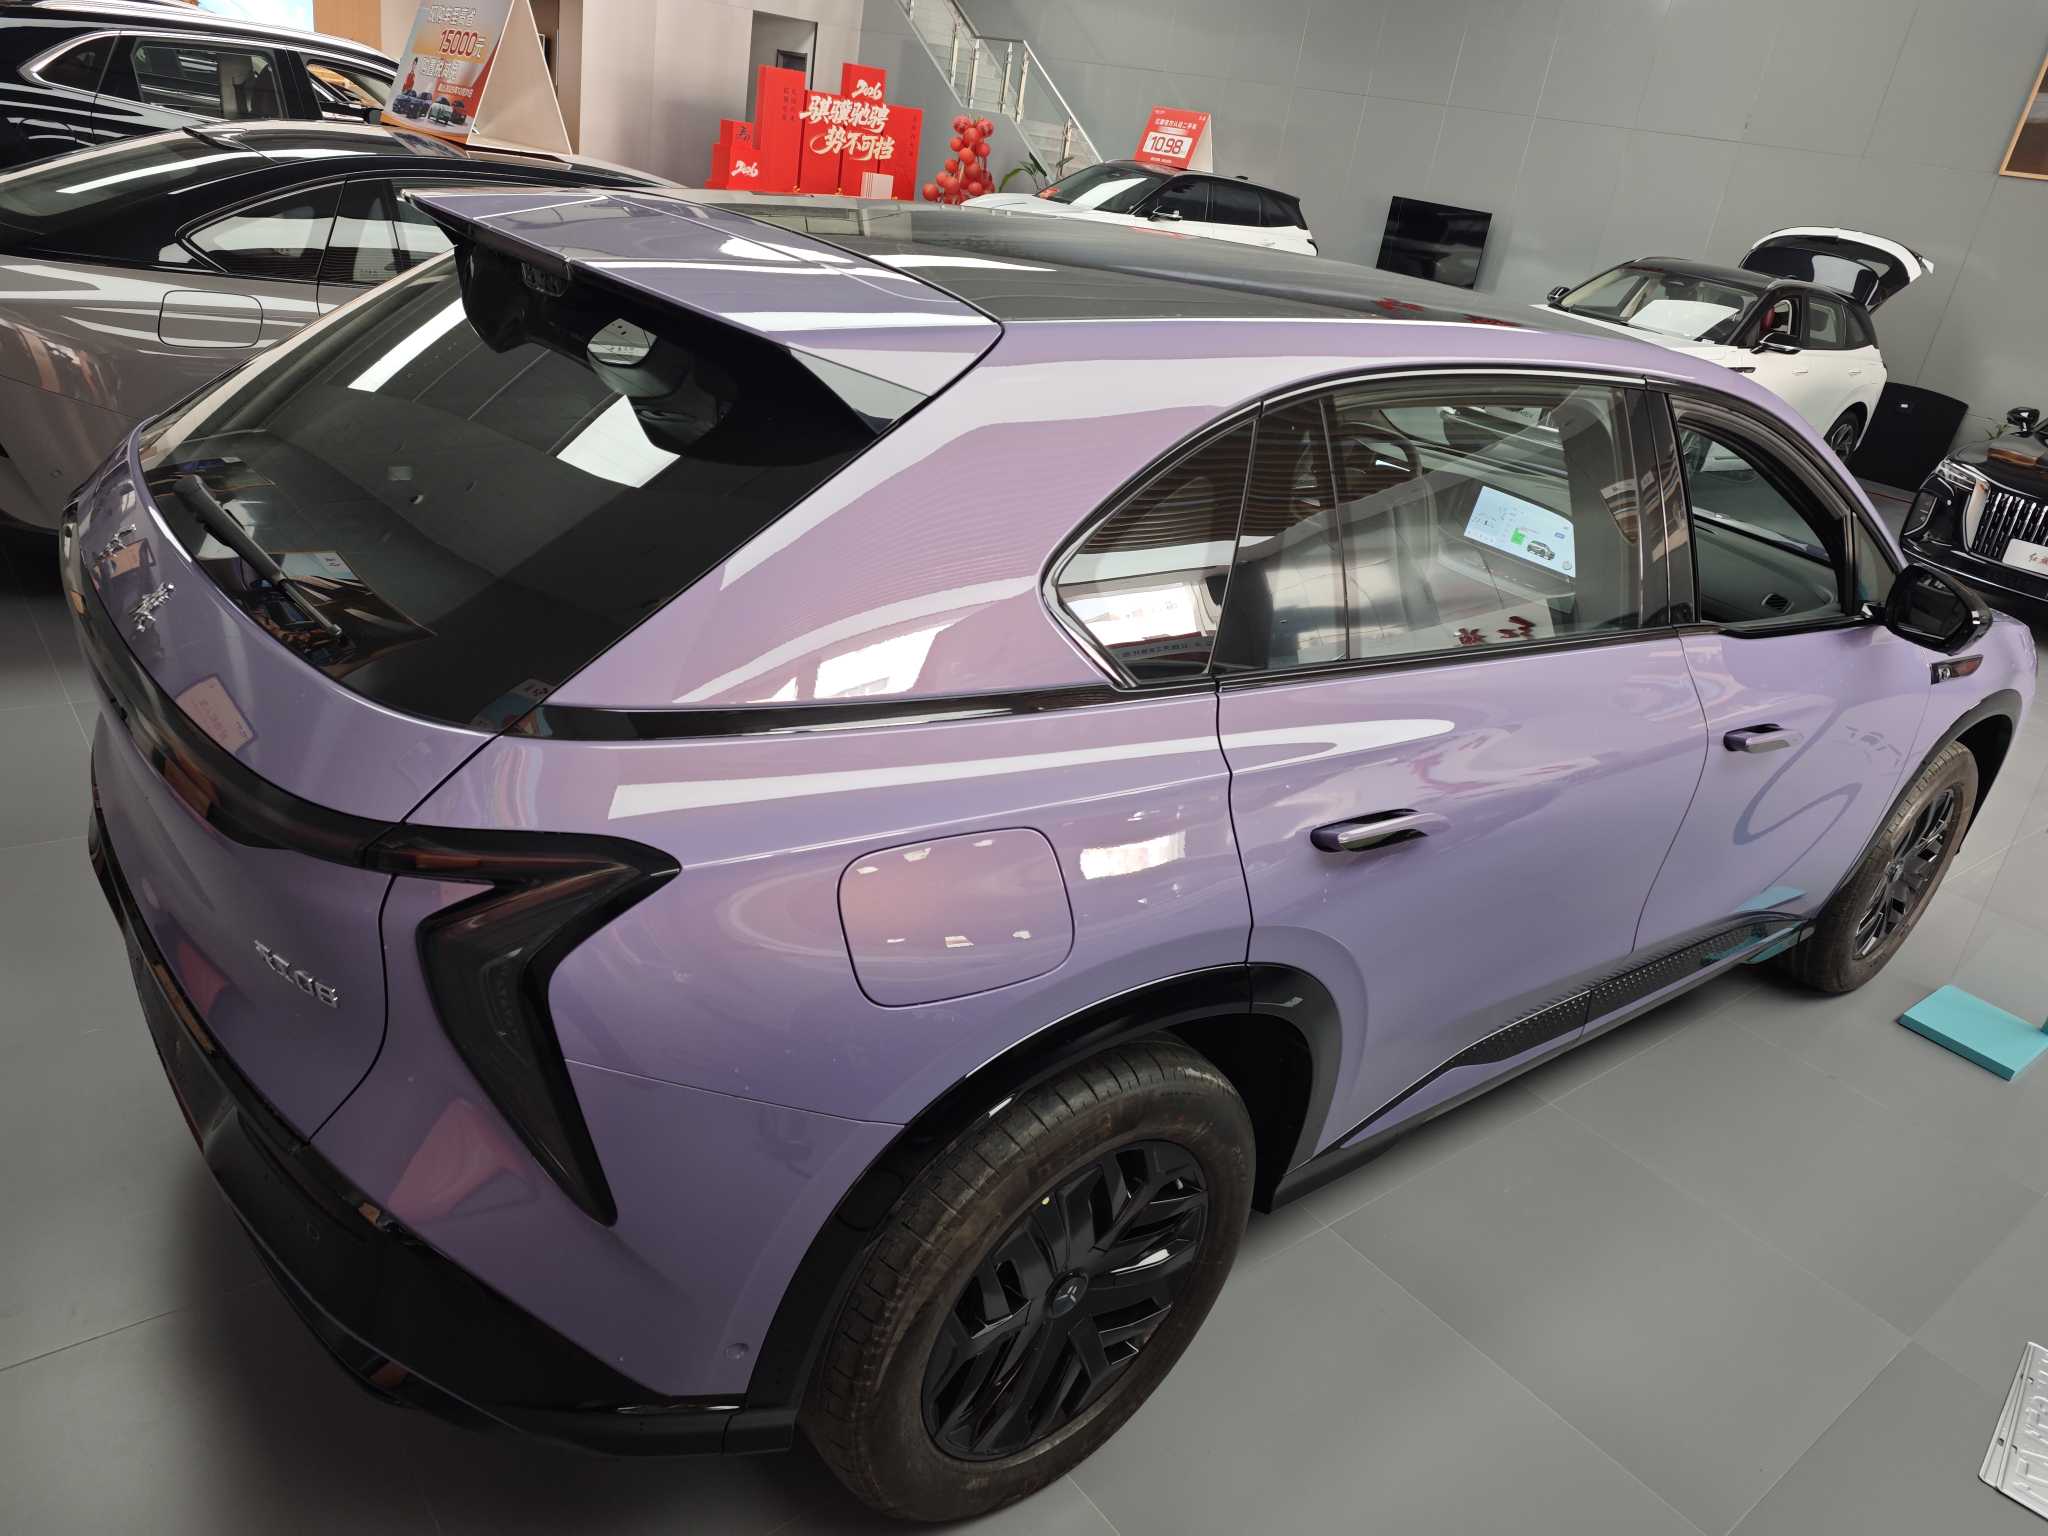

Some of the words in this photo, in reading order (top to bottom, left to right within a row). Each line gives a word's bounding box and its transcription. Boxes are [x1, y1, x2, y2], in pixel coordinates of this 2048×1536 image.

[852, 79, 882, 100] 2026
[810, 125, 895, 161] 势不可挡
[731, 160, 759, 178] 2026
